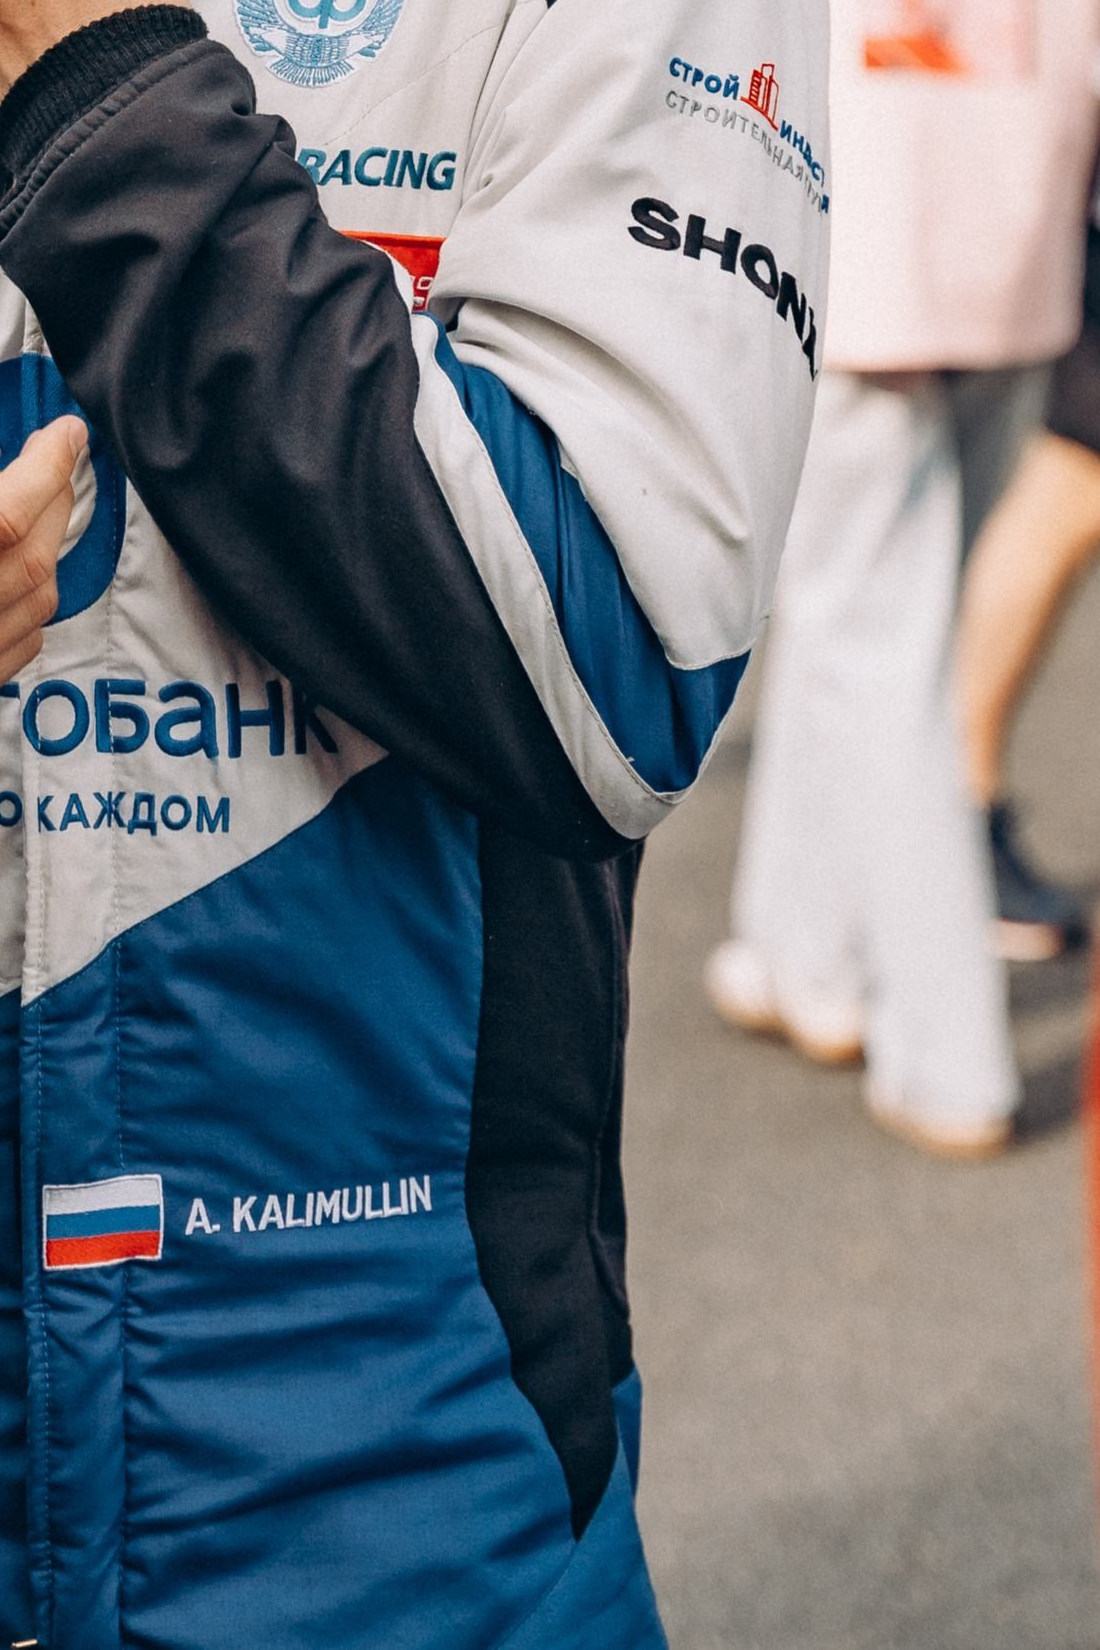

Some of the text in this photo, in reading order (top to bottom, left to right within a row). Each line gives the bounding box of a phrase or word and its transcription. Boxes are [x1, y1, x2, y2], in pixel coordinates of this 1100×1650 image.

[669, 57, 740, 100] СТРОЙ
[297, 146, 457, 191] RACING
[37, 790, 230, 836] КАЖДОМ
[185, 1174, 433, 1235] A. KALIMULLIN
